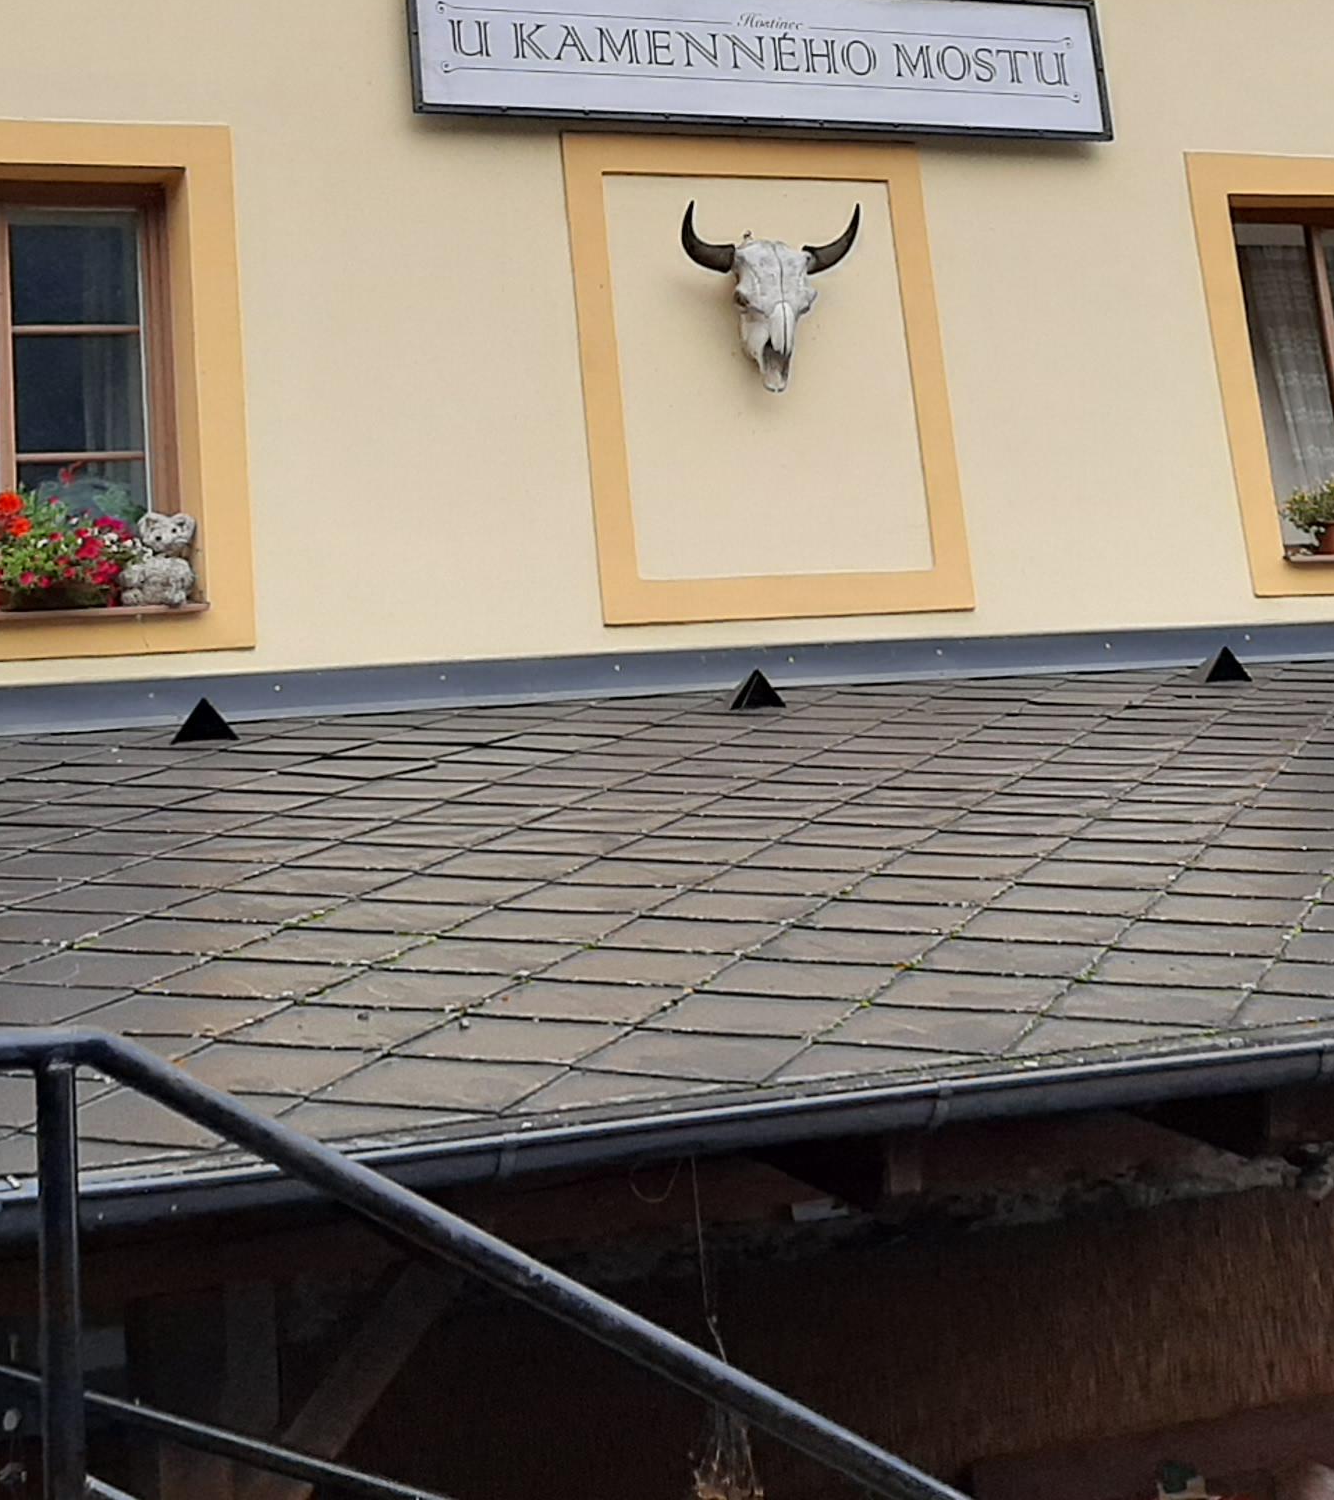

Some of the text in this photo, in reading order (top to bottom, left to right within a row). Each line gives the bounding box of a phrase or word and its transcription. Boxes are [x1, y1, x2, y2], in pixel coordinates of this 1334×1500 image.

[448, 18, 1071, 87] U KAMENNÉHO MOSTU
